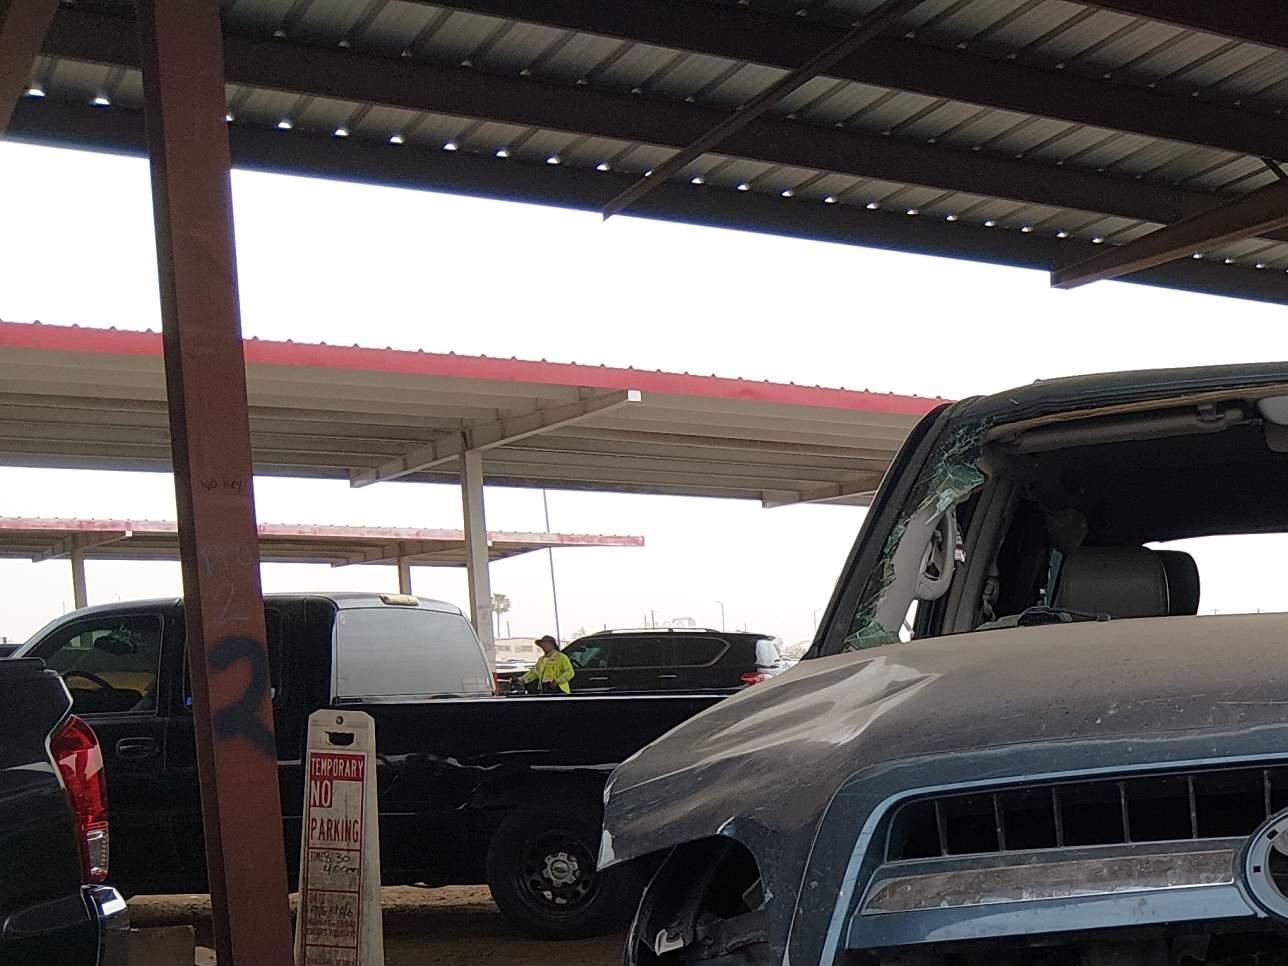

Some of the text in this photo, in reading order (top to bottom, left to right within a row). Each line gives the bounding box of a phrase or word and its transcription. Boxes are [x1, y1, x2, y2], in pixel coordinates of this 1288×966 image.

[311, 757, 364, 778] TEMPORARY
[311, 779, 332, 807] NO
[310, 817, 359, 843] PARKING
